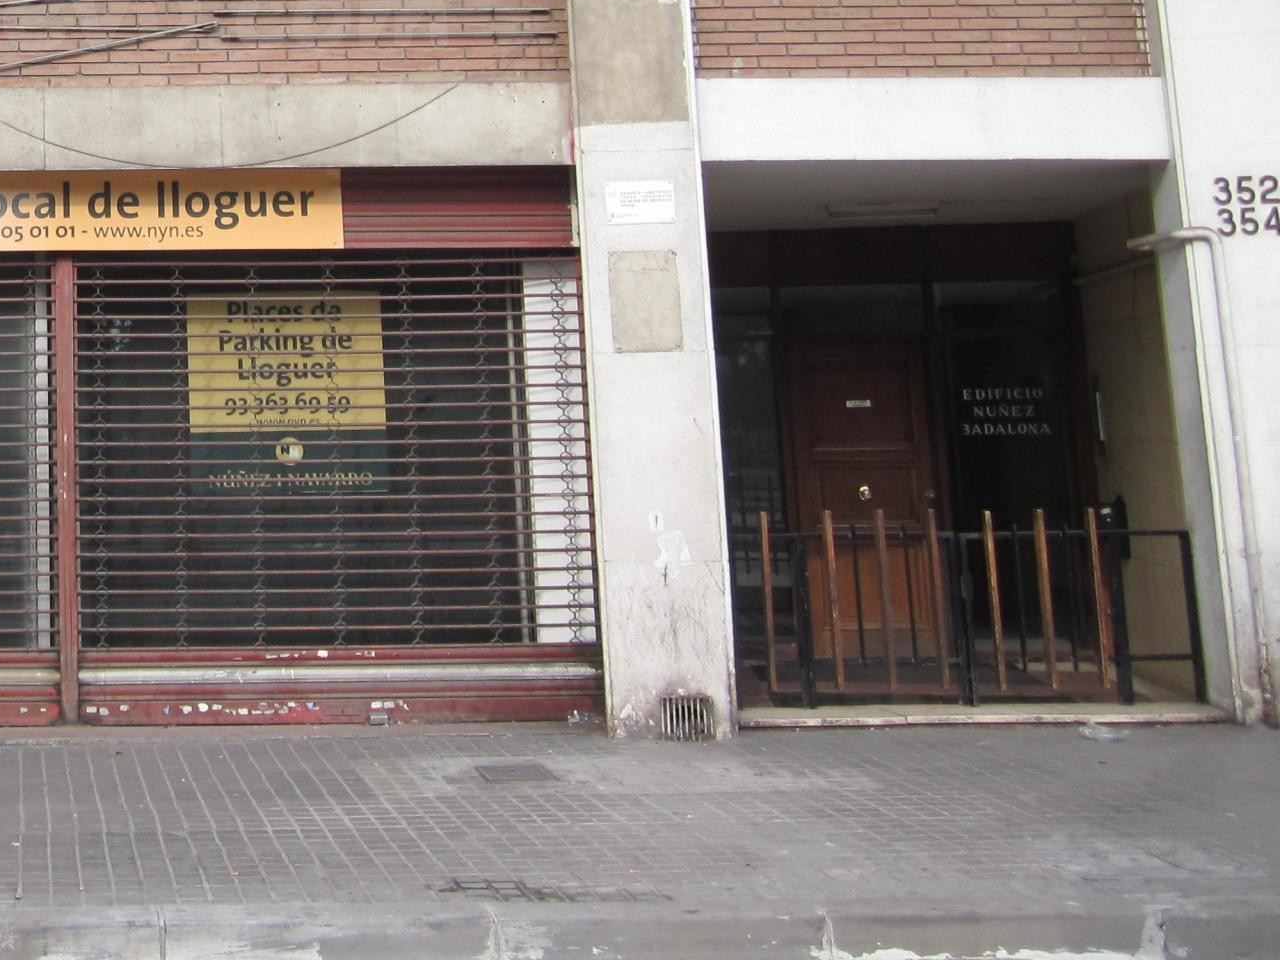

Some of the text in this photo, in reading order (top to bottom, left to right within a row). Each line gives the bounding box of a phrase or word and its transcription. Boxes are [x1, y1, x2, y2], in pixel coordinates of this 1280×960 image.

[1213, 175, 1280, 206] 352
[87, 181, 140, 219] de
[157, 180, 315, 230] lloguer
[29, 225, 49, 238] 01
[55, 225, 76, 238] 01
[93, 224, 204, 243] www.nyn.es
[1217, 206, 1280, 237] 354
[226, 300, 304, 323] Places
[218, 326, 353, 358] Parking de
[237, 358, 337, 387] Lloguer
[224, 397, 248, 416] 93
[254, 393, 289, 415] 363
[295, 392, 320, 415] 69
[962, 388, 1043, 401] EDIFICIO
[973, 404, 1035, 417] NUÑEZ
